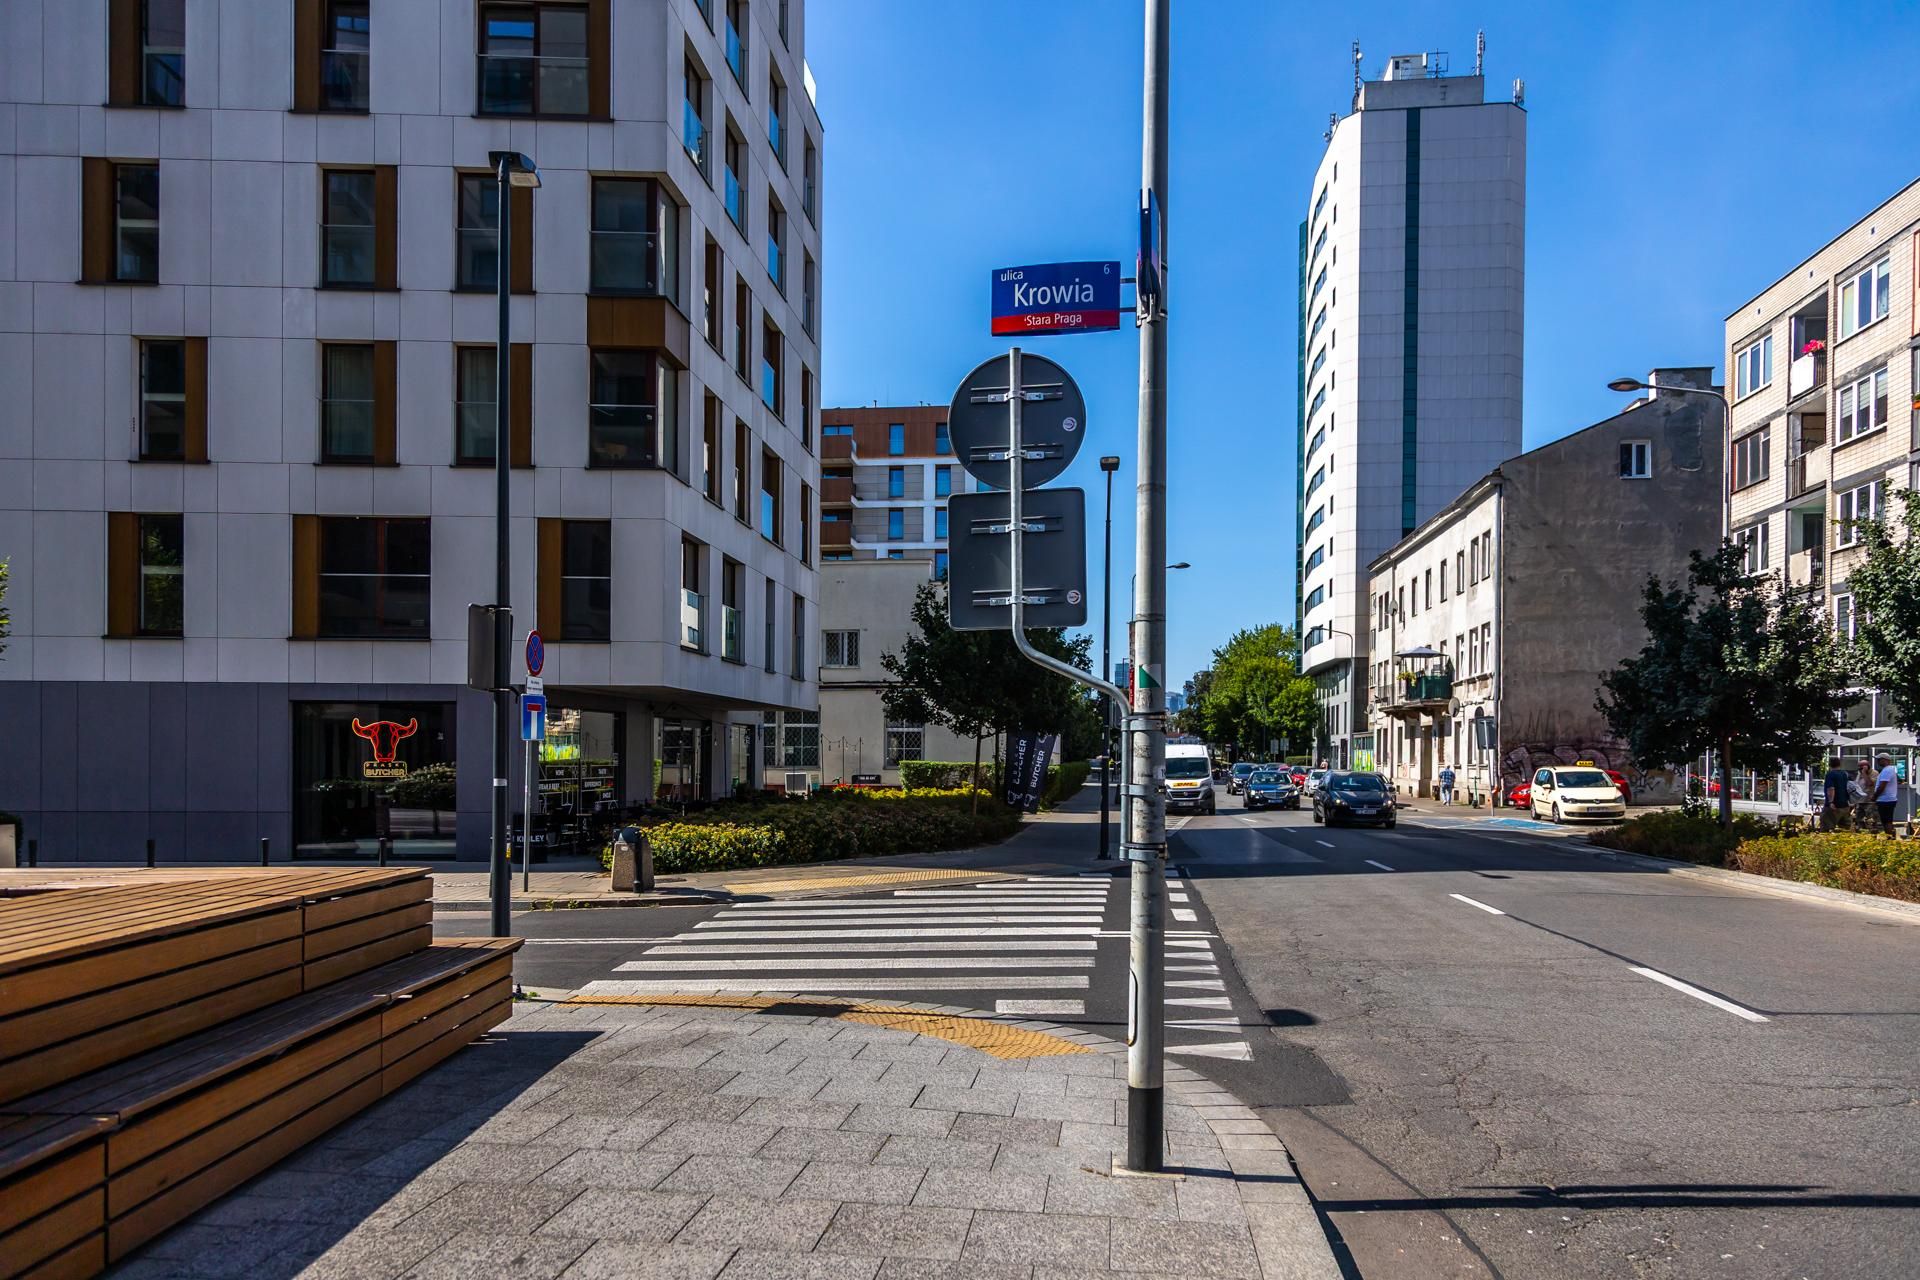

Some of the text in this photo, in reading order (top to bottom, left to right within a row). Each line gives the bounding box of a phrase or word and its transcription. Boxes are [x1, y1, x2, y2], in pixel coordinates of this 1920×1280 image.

[1001, 270, 1023, 281] ulica
[1104, 264, 1110, 274] 6
[1014, 278, 1094, 308] Krowia
[1026, 313, 1082, 326] Stara Praga
[1030, 751, 1045, 787] BUTCHER
